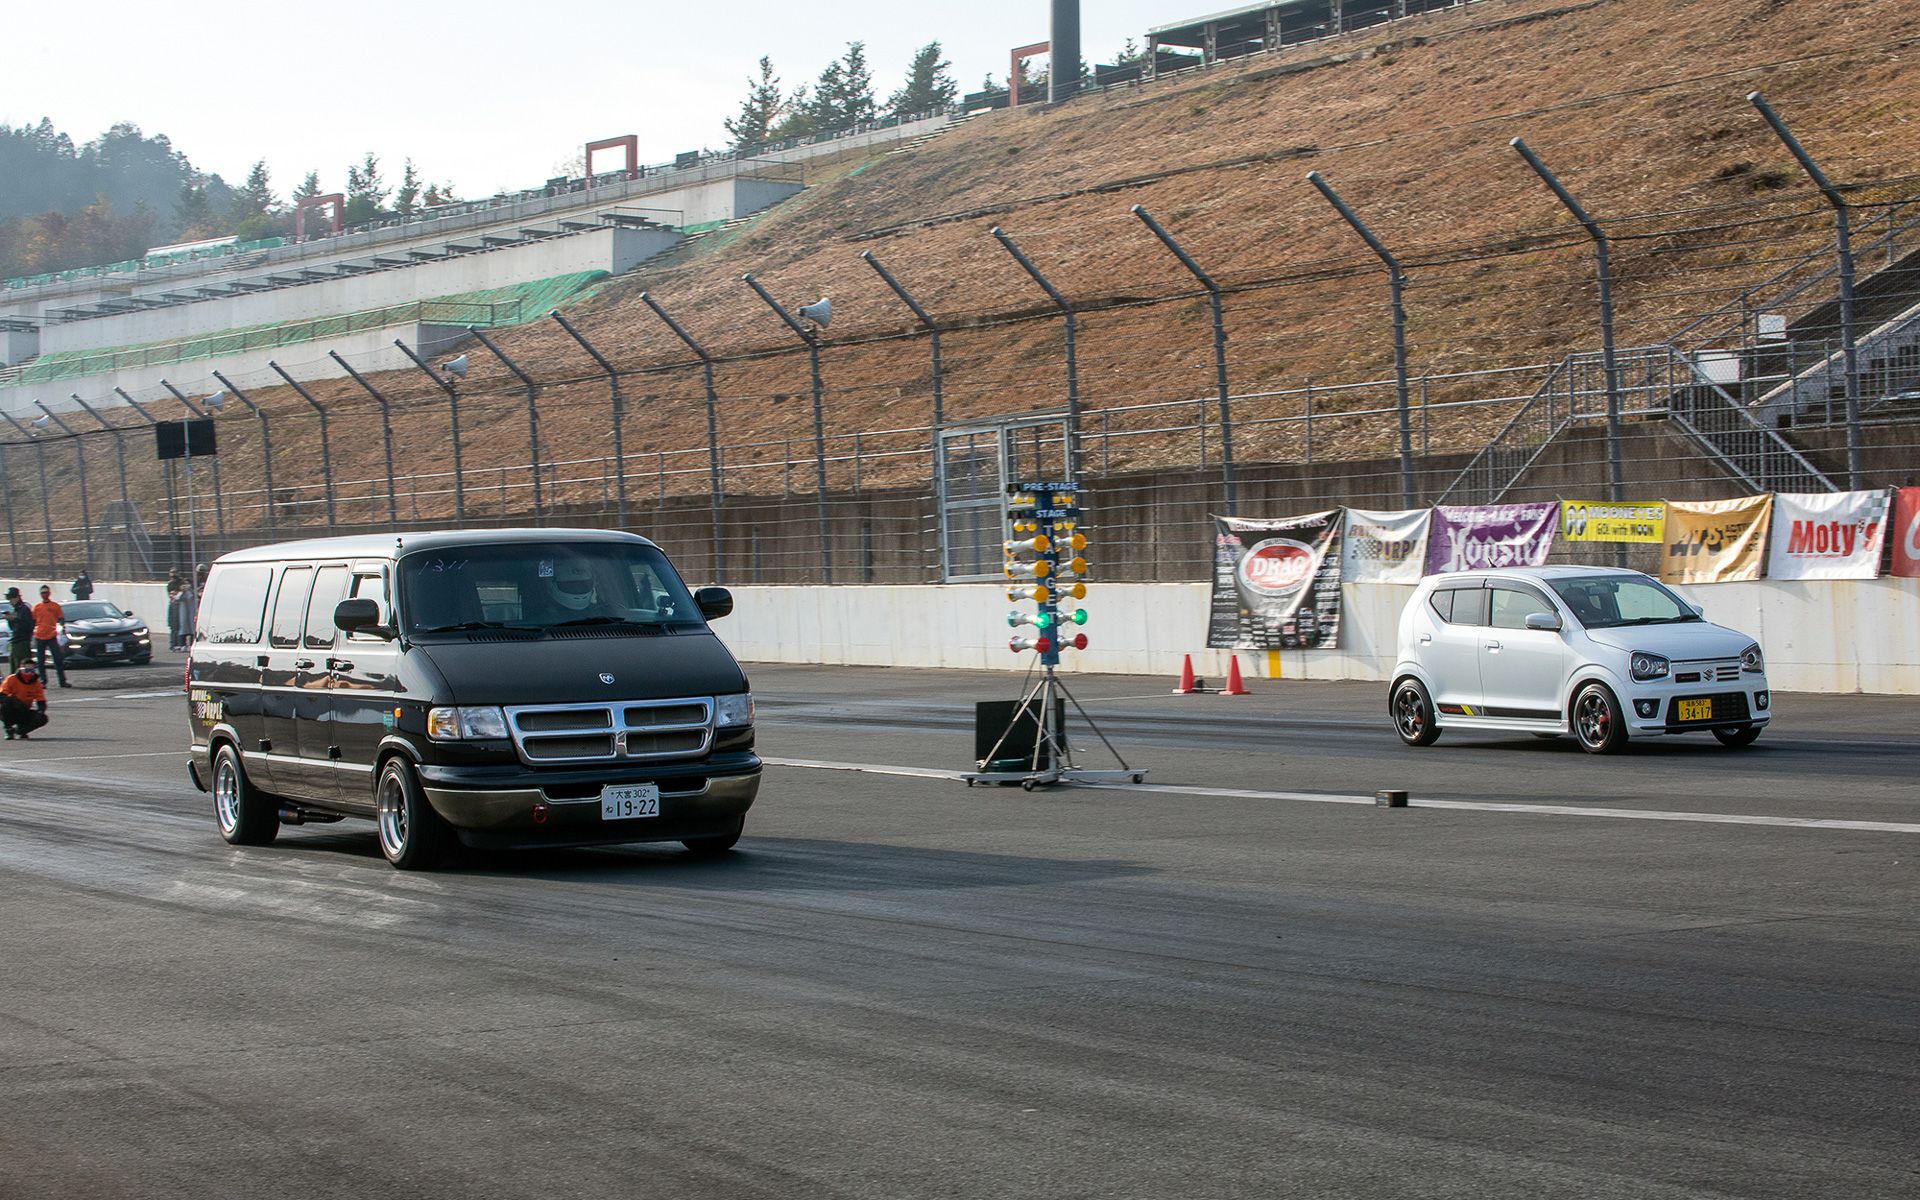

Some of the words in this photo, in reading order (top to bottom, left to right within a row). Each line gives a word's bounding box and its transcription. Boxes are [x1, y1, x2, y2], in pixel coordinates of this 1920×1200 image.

[1023, 482, 1079, 491] PRE-STAGE
[1036, 509, 1067, 518] STAGE
[1521, 508, 1545, 520] FANS
[1588, 505, 1663, 520] MOONEYES
[1300, 515, 1328, 529] FANS
[1787, 519, 1878, 556] Moty's
[1439, 522, 1551, 572] Hoosier
[1251, 556, 1306, 577] DRAG
[1685, 707, 1711, 720] 34-17
[616, 798, 657, 817] 19-22
